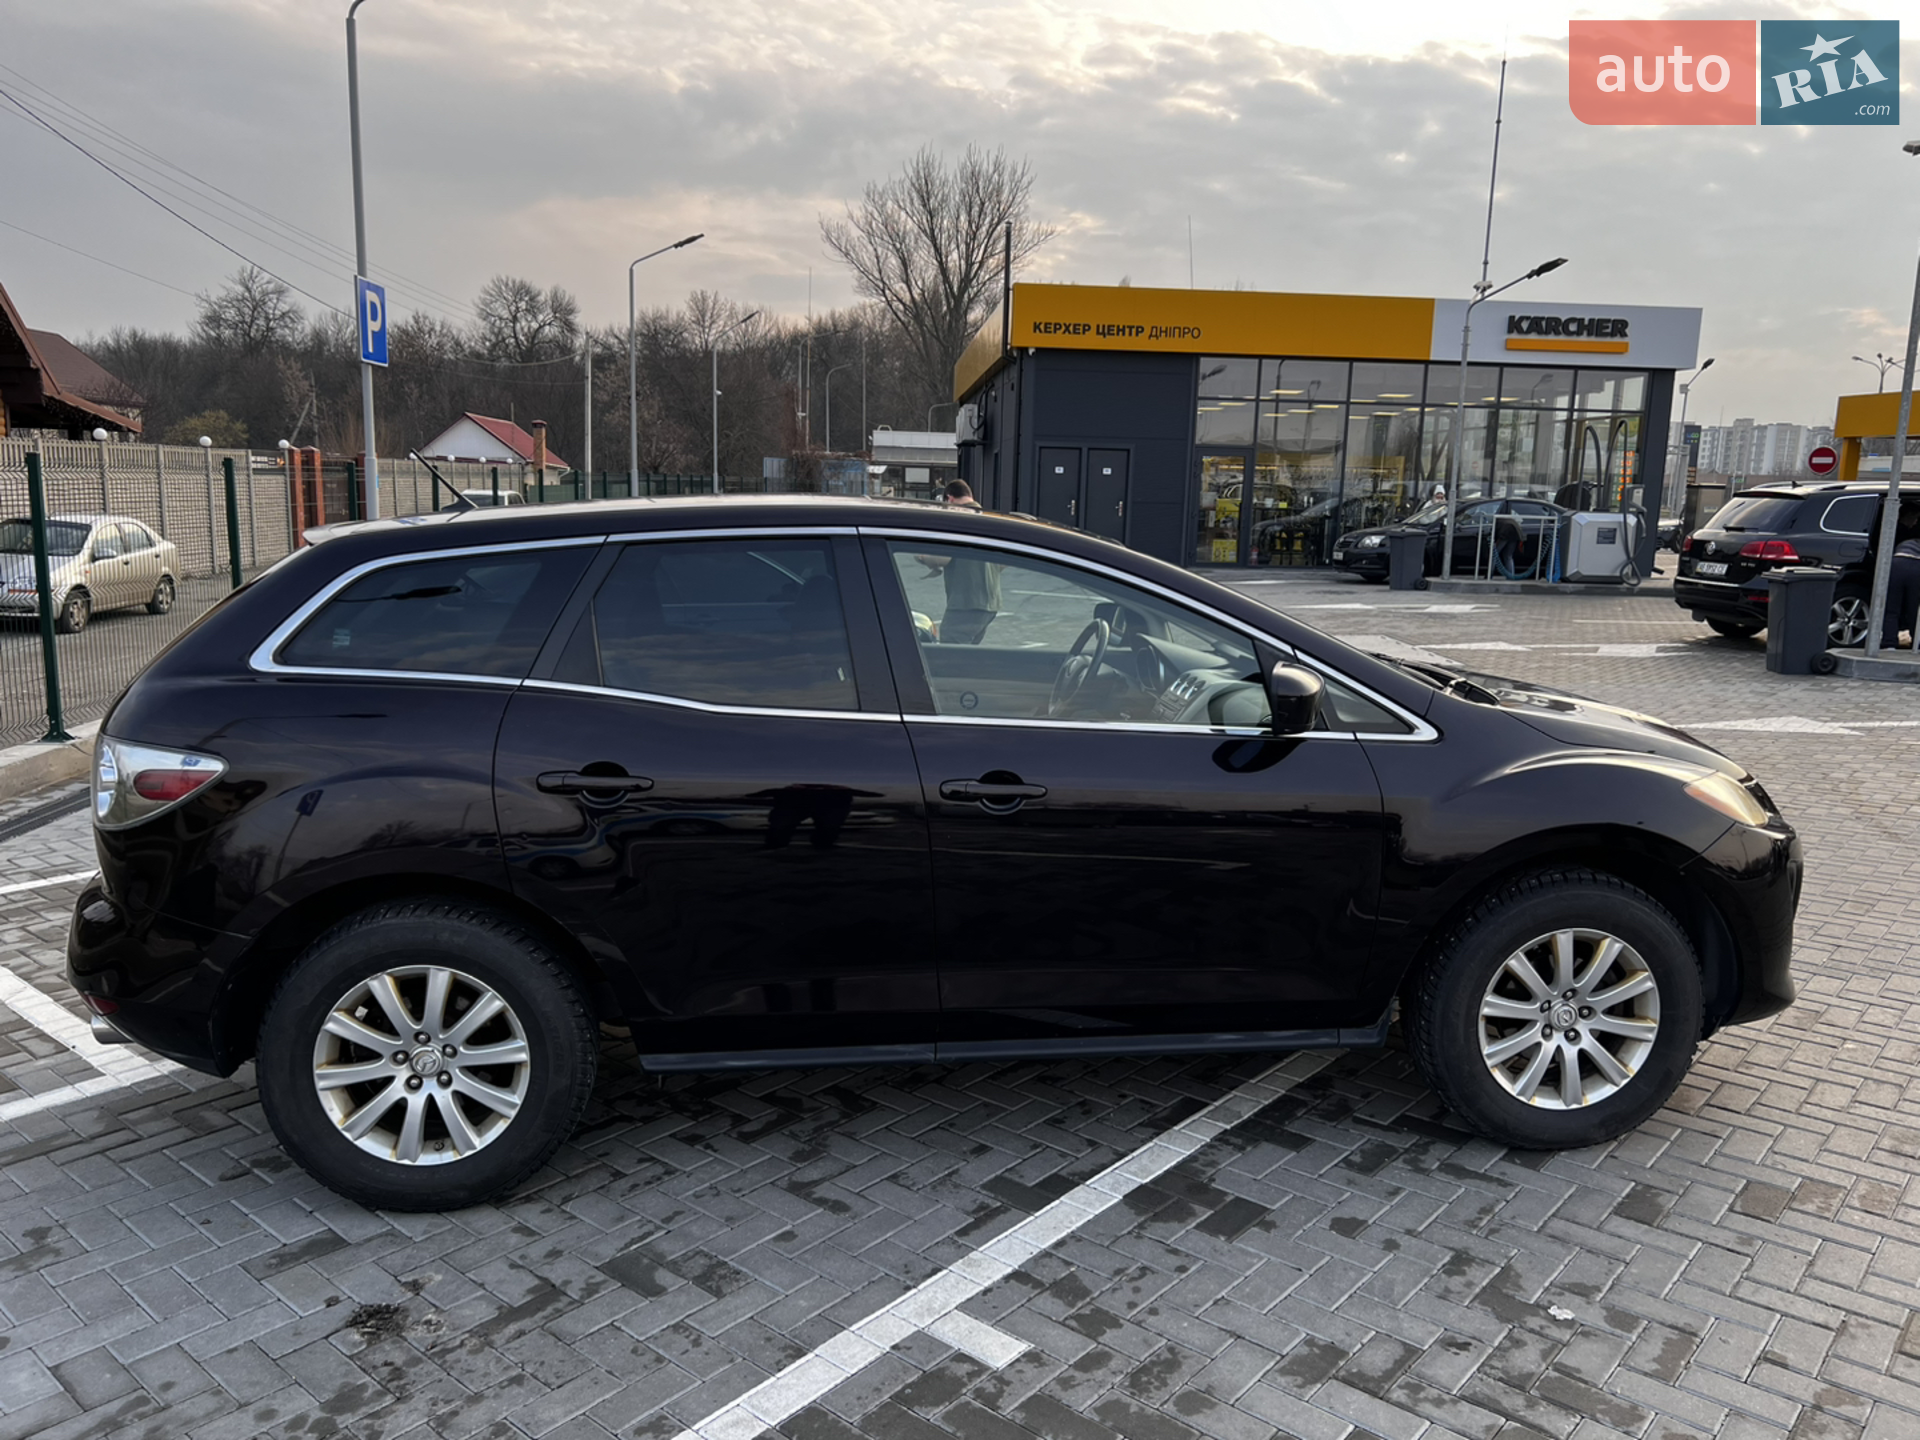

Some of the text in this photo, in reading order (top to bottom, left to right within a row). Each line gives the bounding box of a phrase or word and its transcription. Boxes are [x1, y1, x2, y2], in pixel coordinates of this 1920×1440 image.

[365, 289, 382, 353] P
[1033, 321, 1202, 340] КЕРХЕР ЦЕНТР ДНІПРО
[1507, 315, 1629, 338] KÄRCHER
